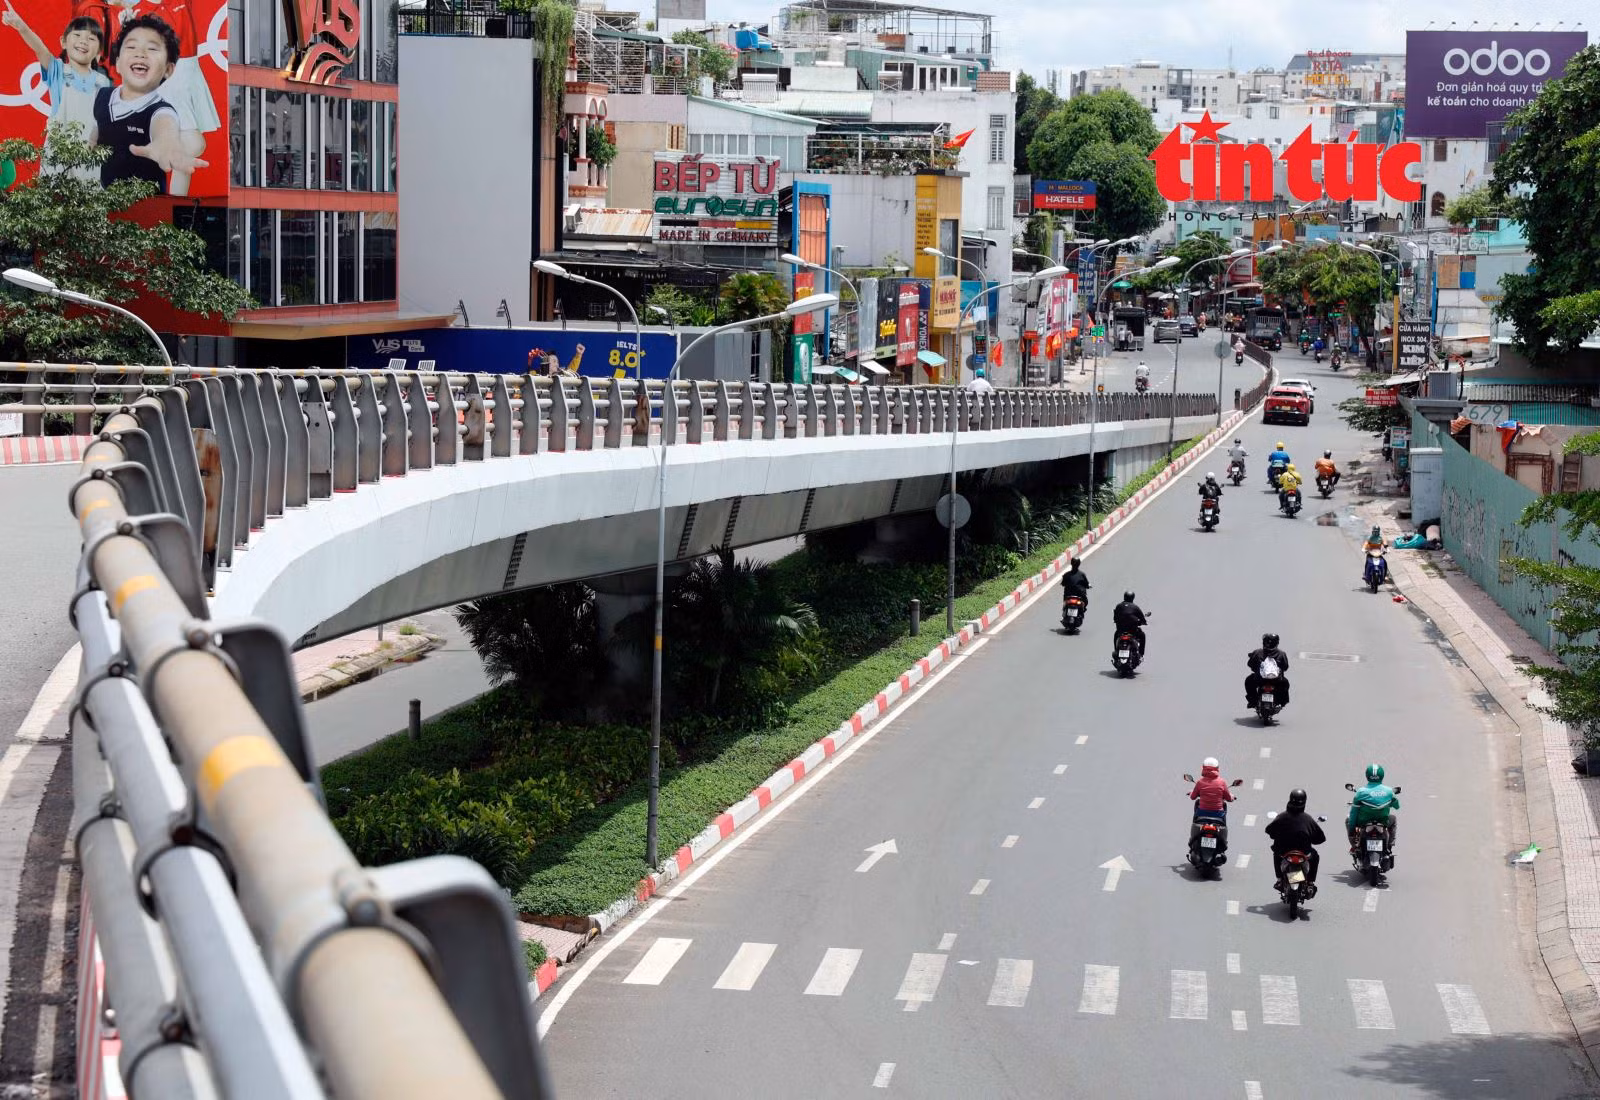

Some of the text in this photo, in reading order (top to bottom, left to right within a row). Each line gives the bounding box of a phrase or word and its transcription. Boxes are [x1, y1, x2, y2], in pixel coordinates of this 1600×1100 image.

[1443, 41, 1551, 76] odoo
[1312, 60, 1343, 71] RITA
[1436, 82, 1459, 92] Đơn
[1461, 81, 1484, 94] giản
[1486, 81, 1506, 92] hoá
[1508, 84, 1529, 94] quy
[1427, 96, 1440, 106] kế
[1442, 97, 1467, 106] toán
[1469, 97, 1490, 106] cho
[1492, 97, 1526, 106] doanh
[655, 153, 780, 194] BẾP TỪ
[655, 195, 778, 216] eurosun
[659, 229, 772, 242] MADE IN GERMANY
[1412, 324, 1430, 332] HÀNG
[919, 326, 927, 350] YONEX
[372, 339, 401, 352] VUS
[616, 340, 638, 351] IELTS
[1469, 405, 1504, 421] 679
